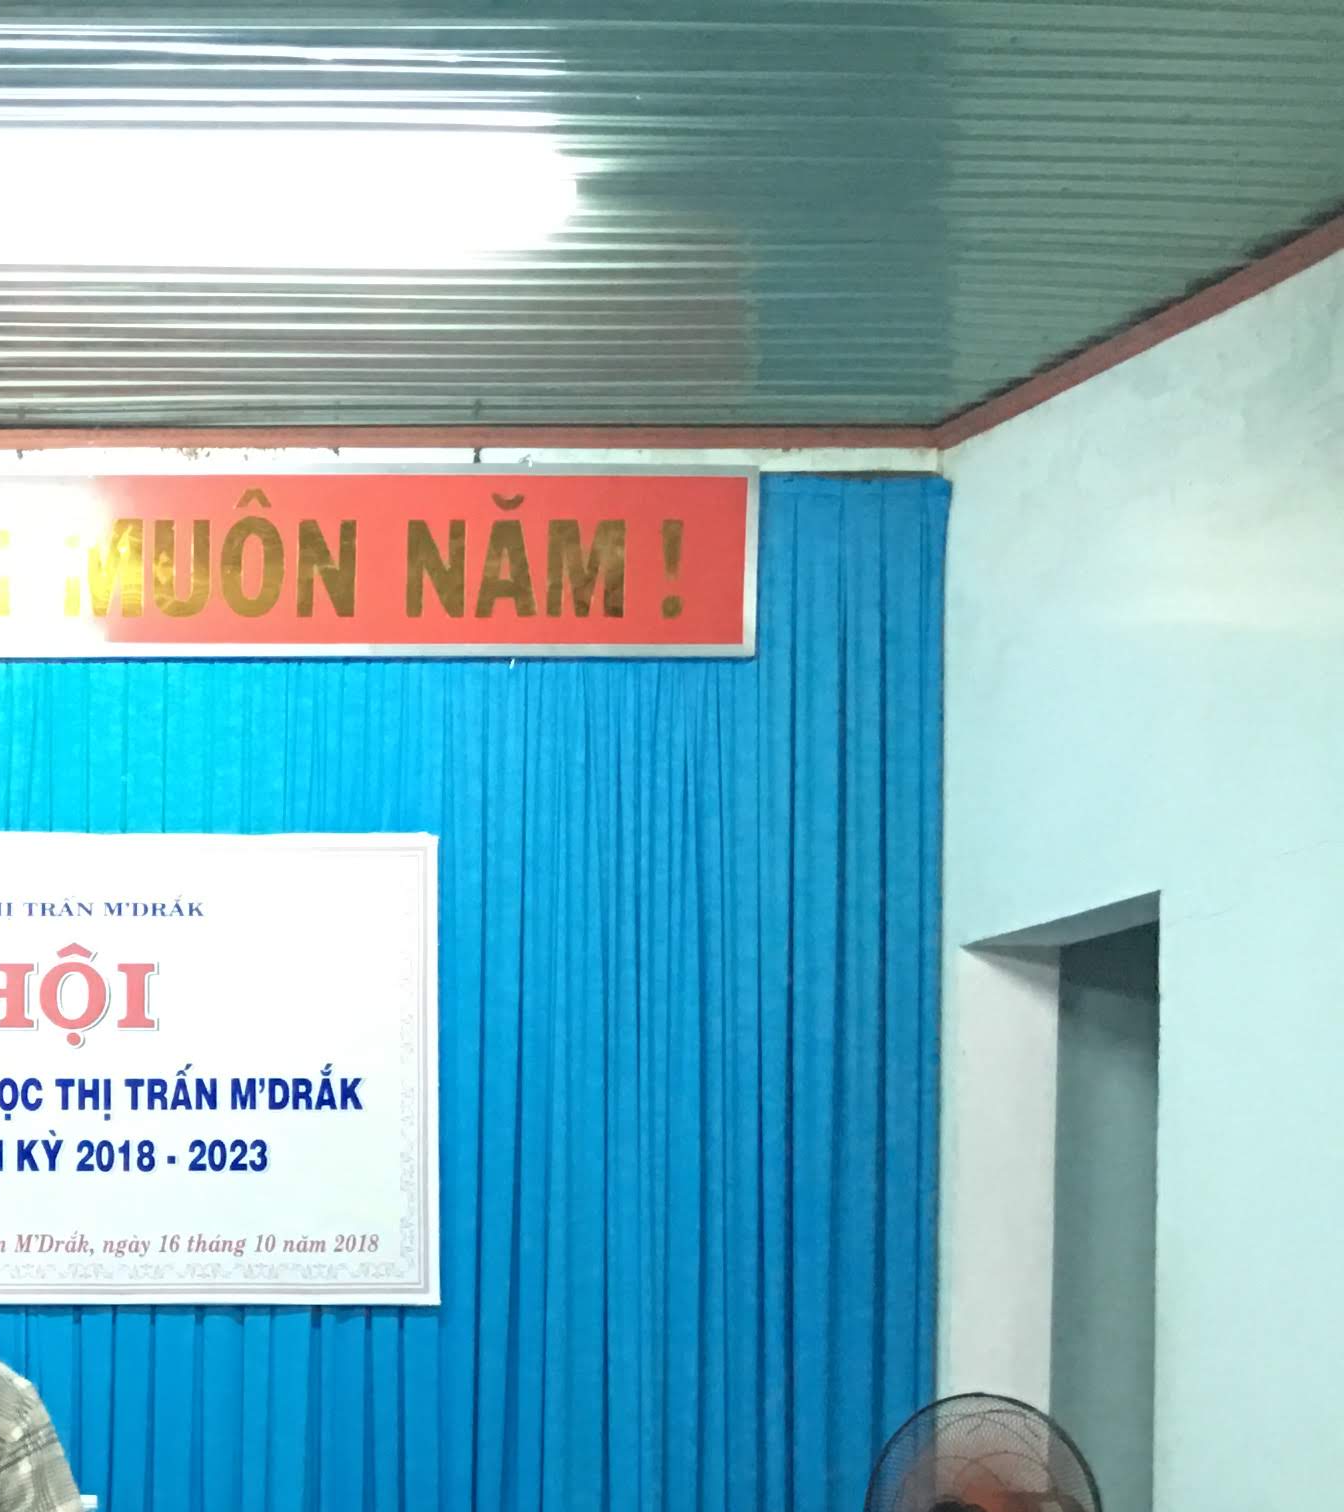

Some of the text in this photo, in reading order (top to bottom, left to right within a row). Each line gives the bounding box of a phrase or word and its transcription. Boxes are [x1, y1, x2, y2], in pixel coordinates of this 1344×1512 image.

[64, 488, 357, 618] MUÔN
[405, 492, 625, 618] NĂM
[55, 1078, 111, 1121] THỊ
[125, 1064, 217, 1111] TRẤN
[230, 1064, 363, 1111] M'DRẮK
[18, 1130, 63, 1171] KỲ
[76, 1140, 154, 1172] 2018
[189, 1140, 268, 1172] 2023
[103, 1234, 150, 1257] ngày
[159, 1234, 180, 1253] 16
[187, 1233, 246, 1257] tháng
[255, 1234, 277, 1253] 10
[283, 1235, 326, 1253] năm
[334, 1234, 380, 1253] 2018
